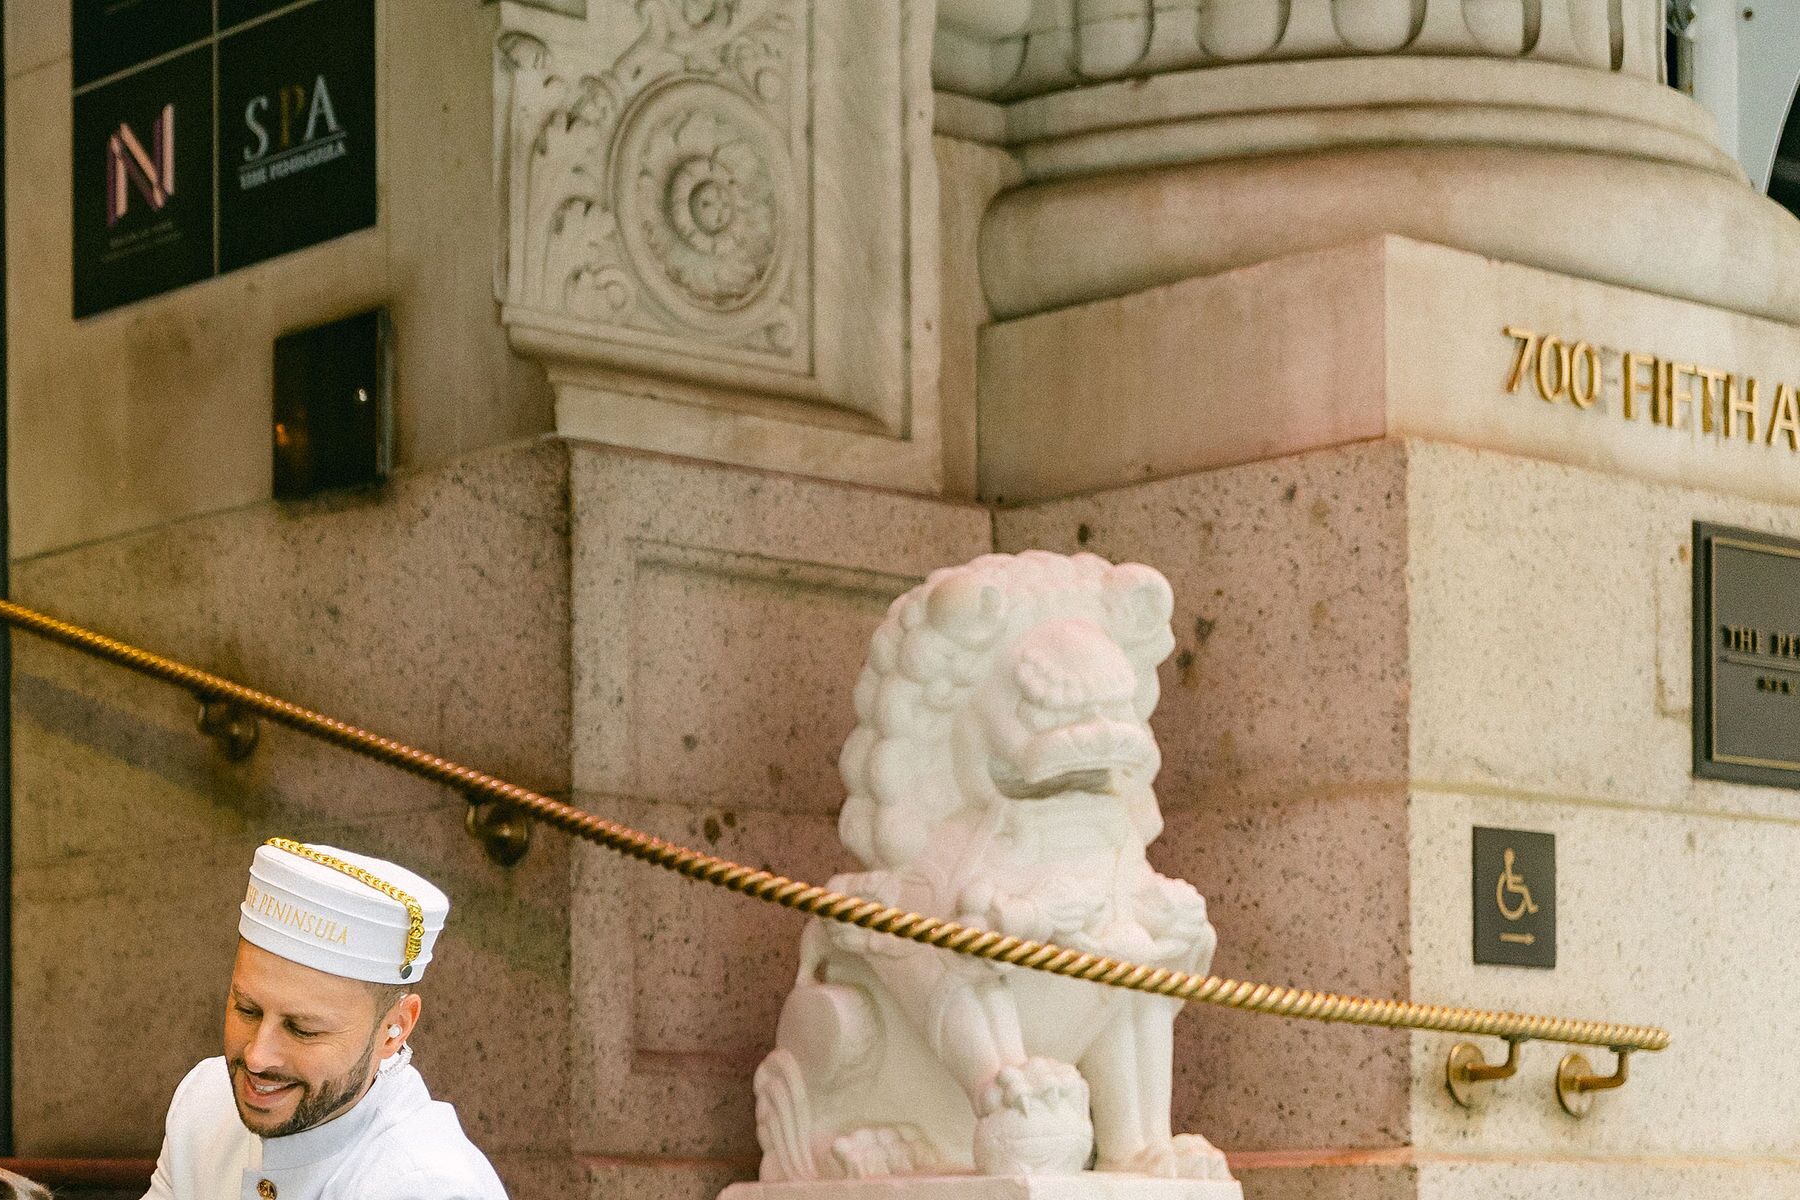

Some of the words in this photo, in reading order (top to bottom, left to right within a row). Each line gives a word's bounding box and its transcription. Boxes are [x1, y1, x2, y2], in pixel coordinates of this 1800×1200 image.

[244, 75, 336, 161] SPA
[1502, 325, 1601, 410] 700
[1623, 351, 1759, 443] FIFTH
[1766, 381, 1800, 452] A
[1769, 630, 1800, 660] PE
[258, 893, 348, 945] PENINSULA
